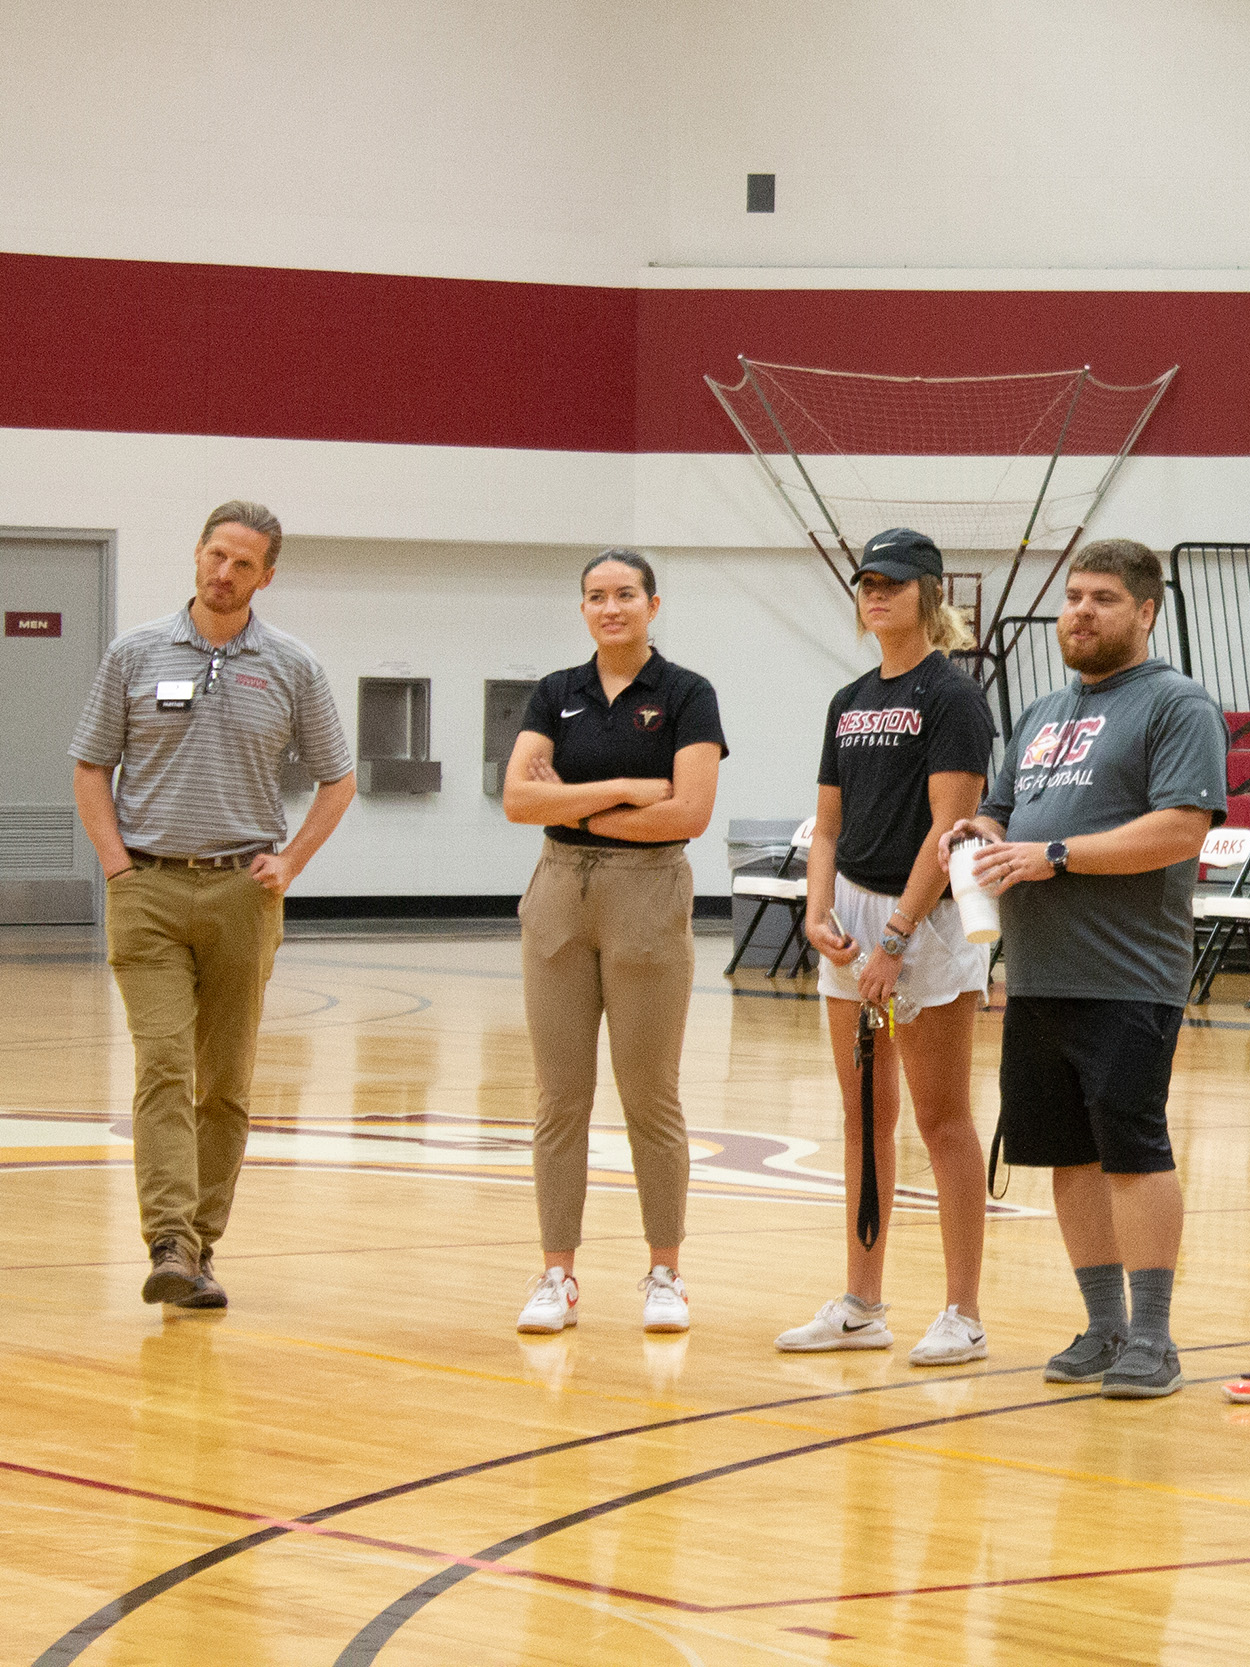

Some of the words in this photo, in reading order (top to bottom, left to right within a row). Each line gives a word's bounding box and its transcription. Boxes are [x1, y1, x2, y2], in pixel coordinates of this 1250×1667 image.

[18, 620, 48, 629] MEN
[835, 707, 922, 738] HESSTON
[840, 734, 899, 748] SOFTBALL
[1202, 839, 1246, 854] LARKS
